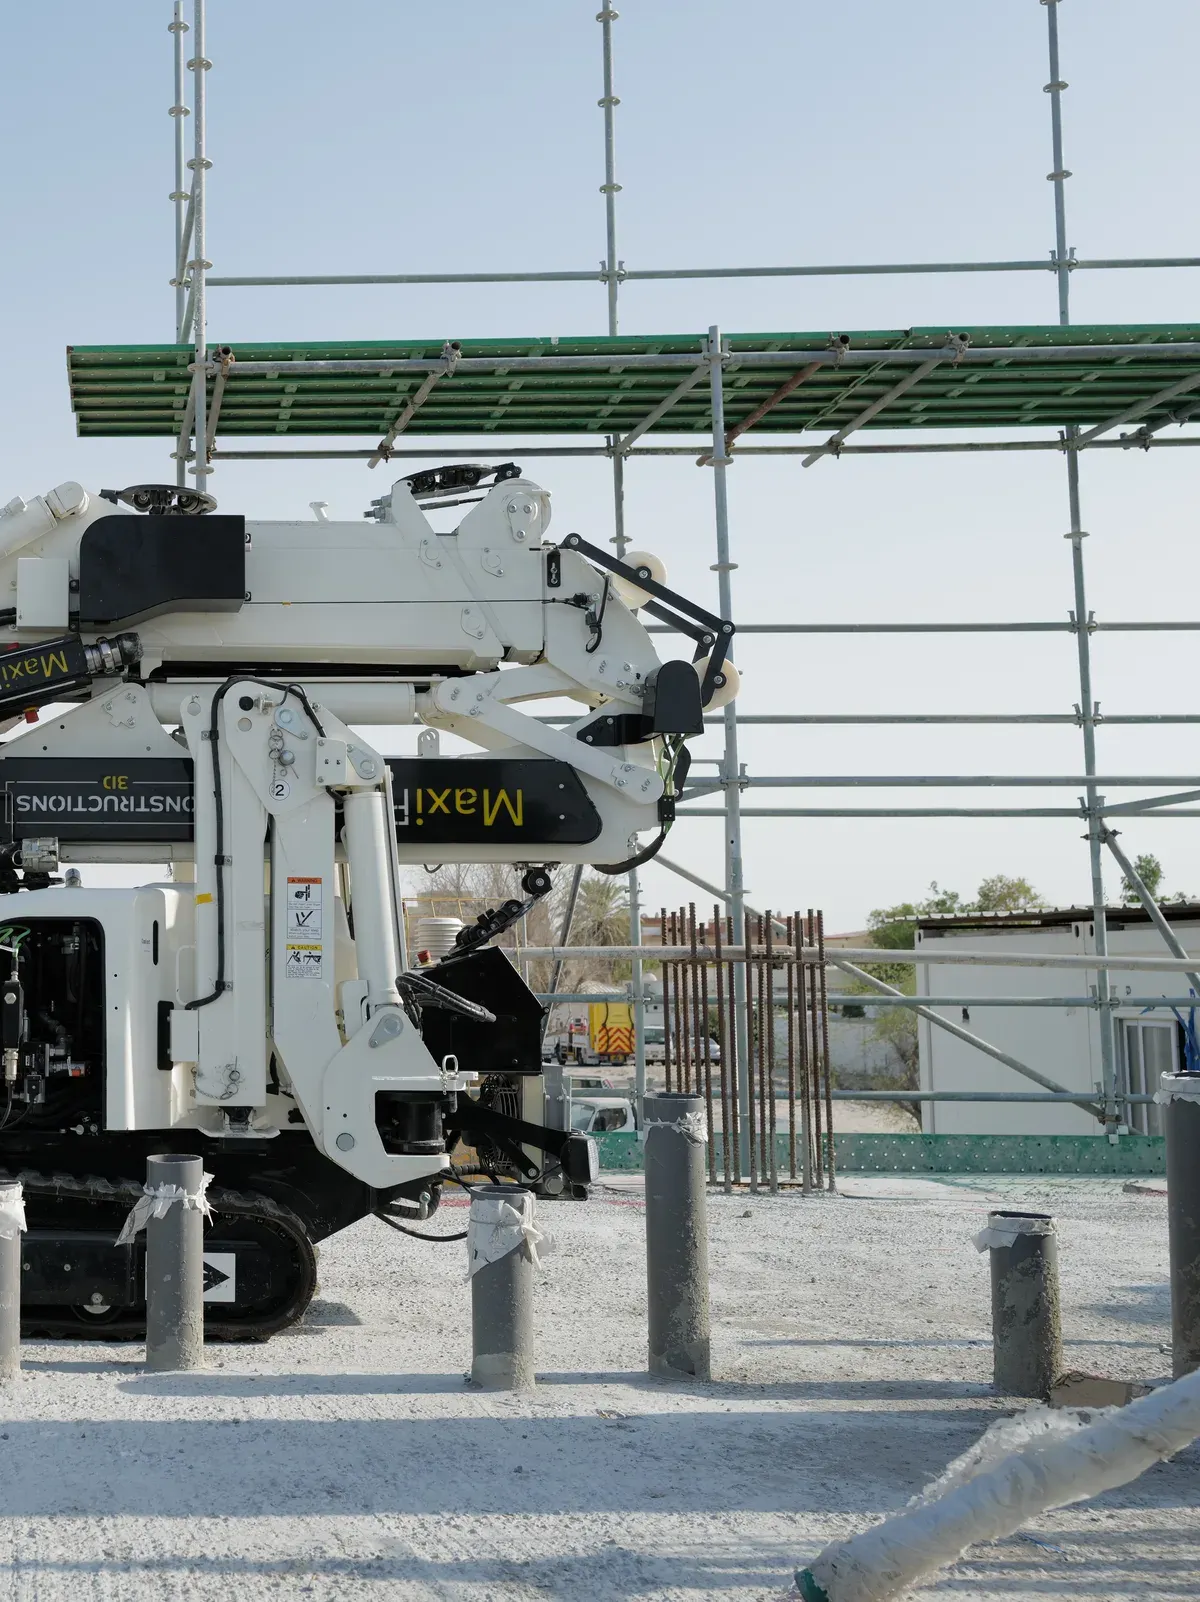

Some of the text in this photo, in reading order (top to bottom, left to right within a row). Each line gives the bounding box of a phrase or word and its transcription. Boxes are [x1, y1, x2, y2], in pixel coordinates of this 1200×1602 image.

[103, 775, 129, 790] 3D
[275, 785, 284, 796] 2
[17, 795, 195, 812] ONSTRUCTIONS
